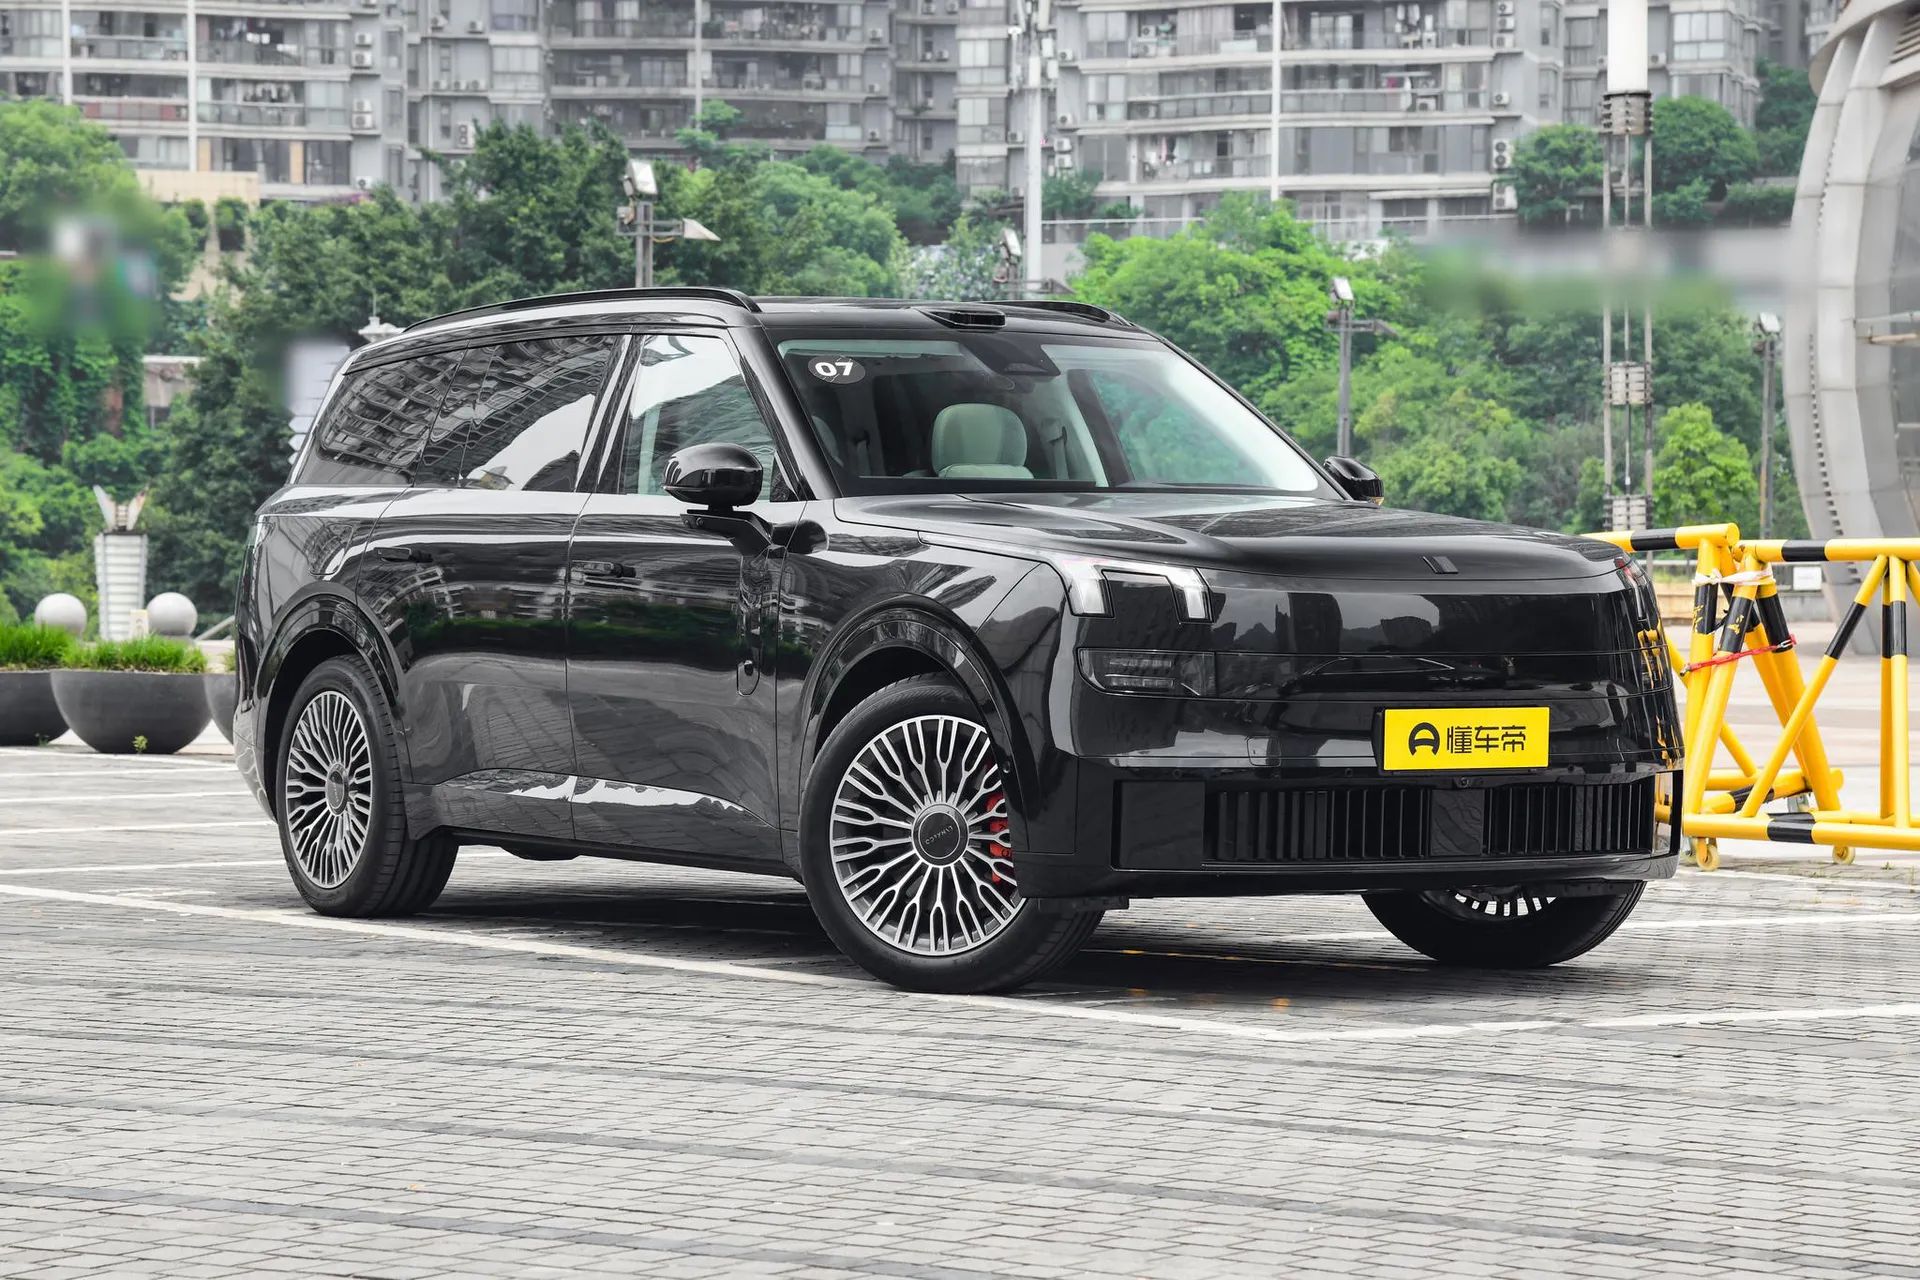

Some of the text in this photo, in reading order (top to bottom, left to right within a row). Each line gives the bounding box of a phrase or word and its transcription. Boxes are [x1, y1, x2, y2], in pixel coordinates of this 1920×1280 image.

[815, 361, 854, 377] 07
[1446, 725, 1526, 754] 懂车帝
